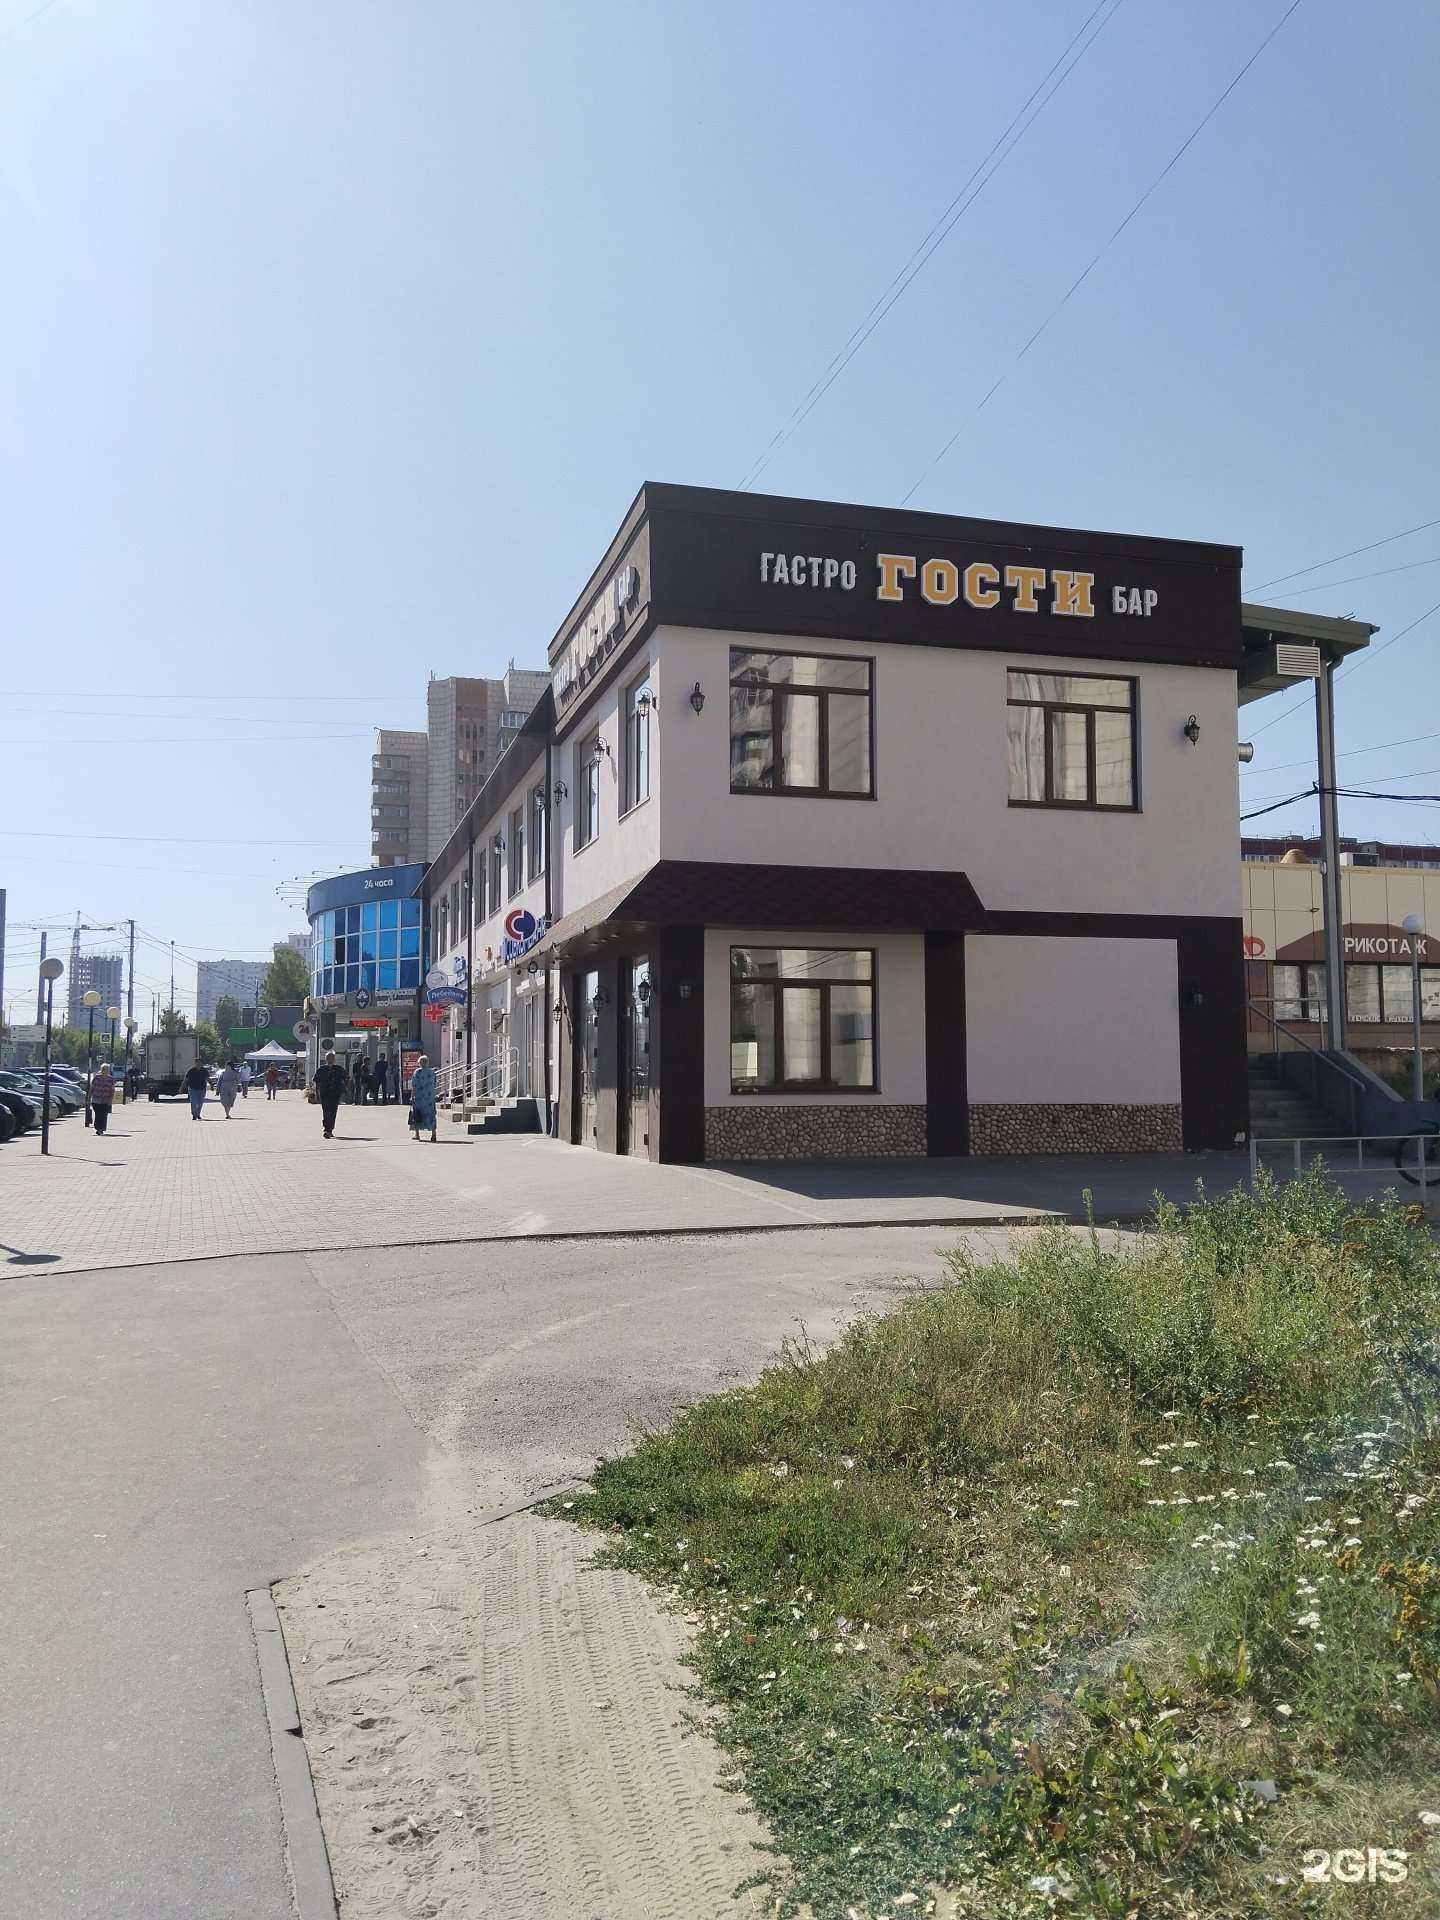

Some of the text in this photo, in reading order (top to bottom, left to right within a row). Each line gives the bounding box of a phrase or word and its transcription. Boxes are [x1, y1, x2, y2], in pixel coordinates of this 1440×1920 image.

[760, 551, 1159, 618] ГАСТРО ГОСТИ БАР
[364, 880, 374, 889] 24
[1342, 936, 1428, 955] РИКОТАЖ
[298, 1024, 311, 1034] 24
